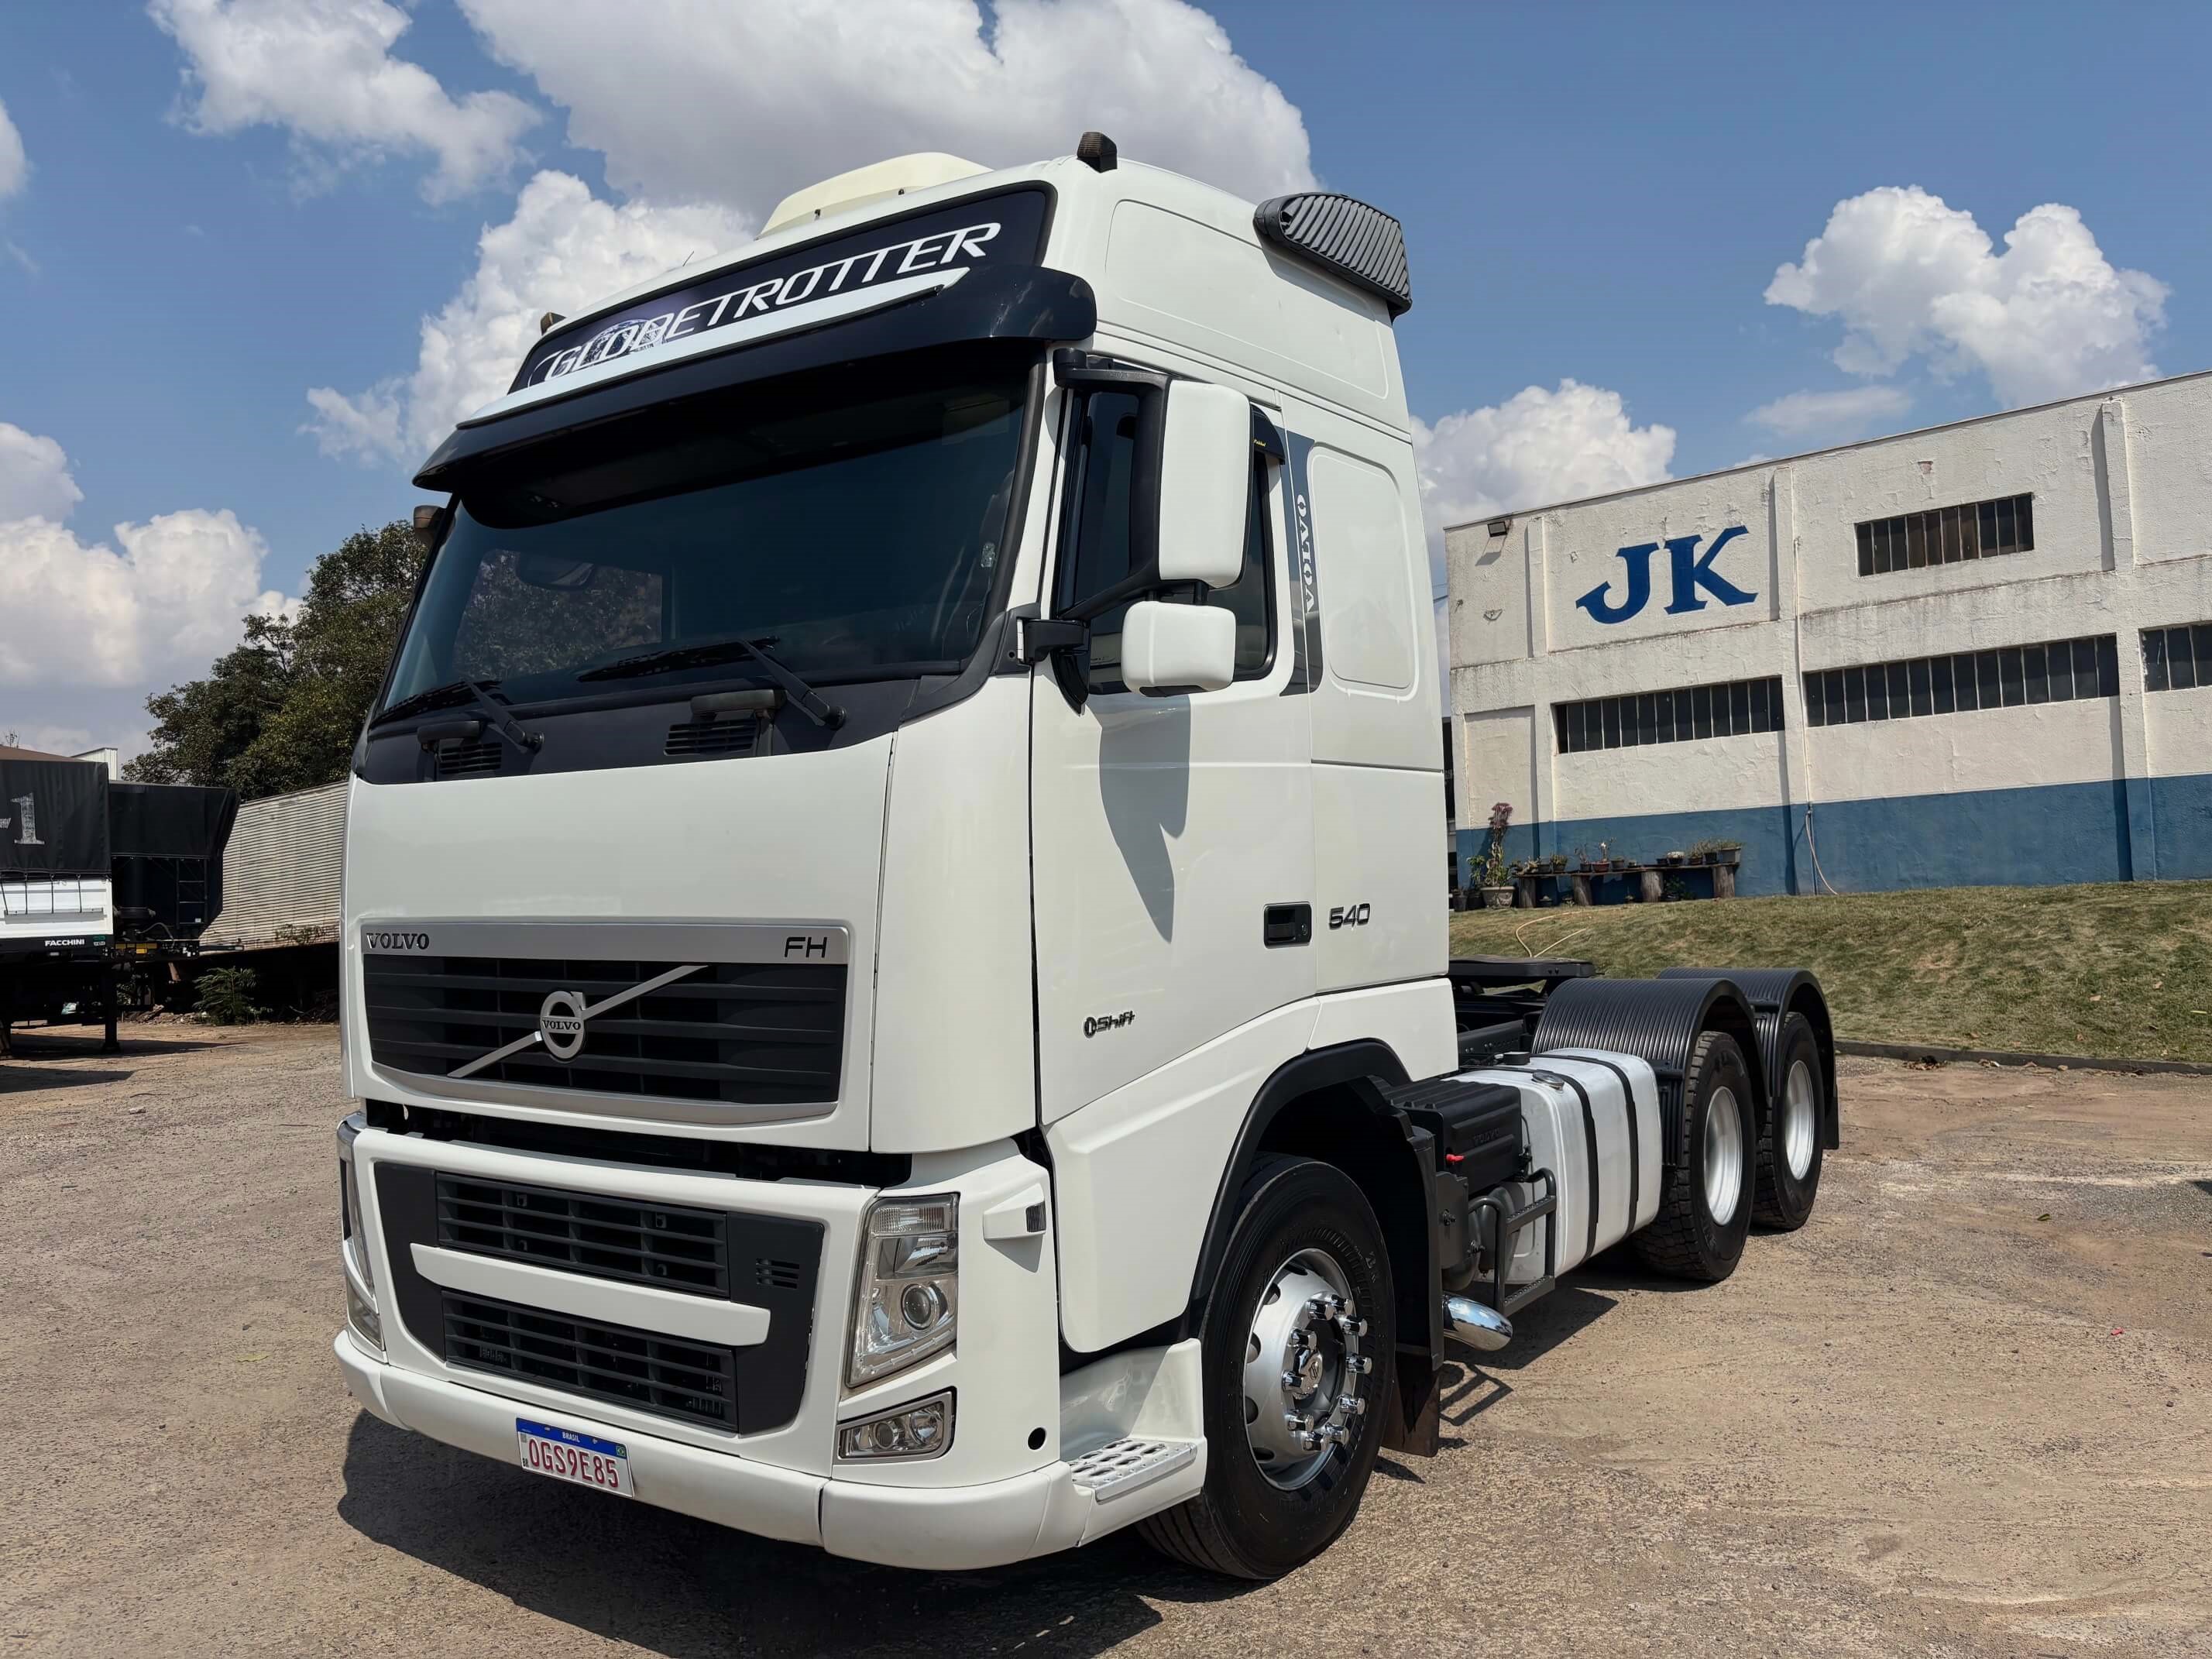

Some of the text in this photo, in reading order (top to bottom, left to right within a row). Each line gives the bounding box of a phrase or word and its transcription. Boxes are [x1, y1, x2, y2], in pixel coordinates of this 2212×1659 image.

[541, 222, 1001, 381] GLOBETROTTER
[1297, 494, 1314, 613] VOLVO
[1575, 524, 1758, 624] JK
[1328, 902, 1371, 930] 540
[44, 939, 85, 947] FACCHINI
[366, 932, 430, 950] VOLVO
[784, 936, 828, 958] FH
[542, 1019, 582, 1032] VOLVO
[562, 1431, 581, 1443] BRASIL
